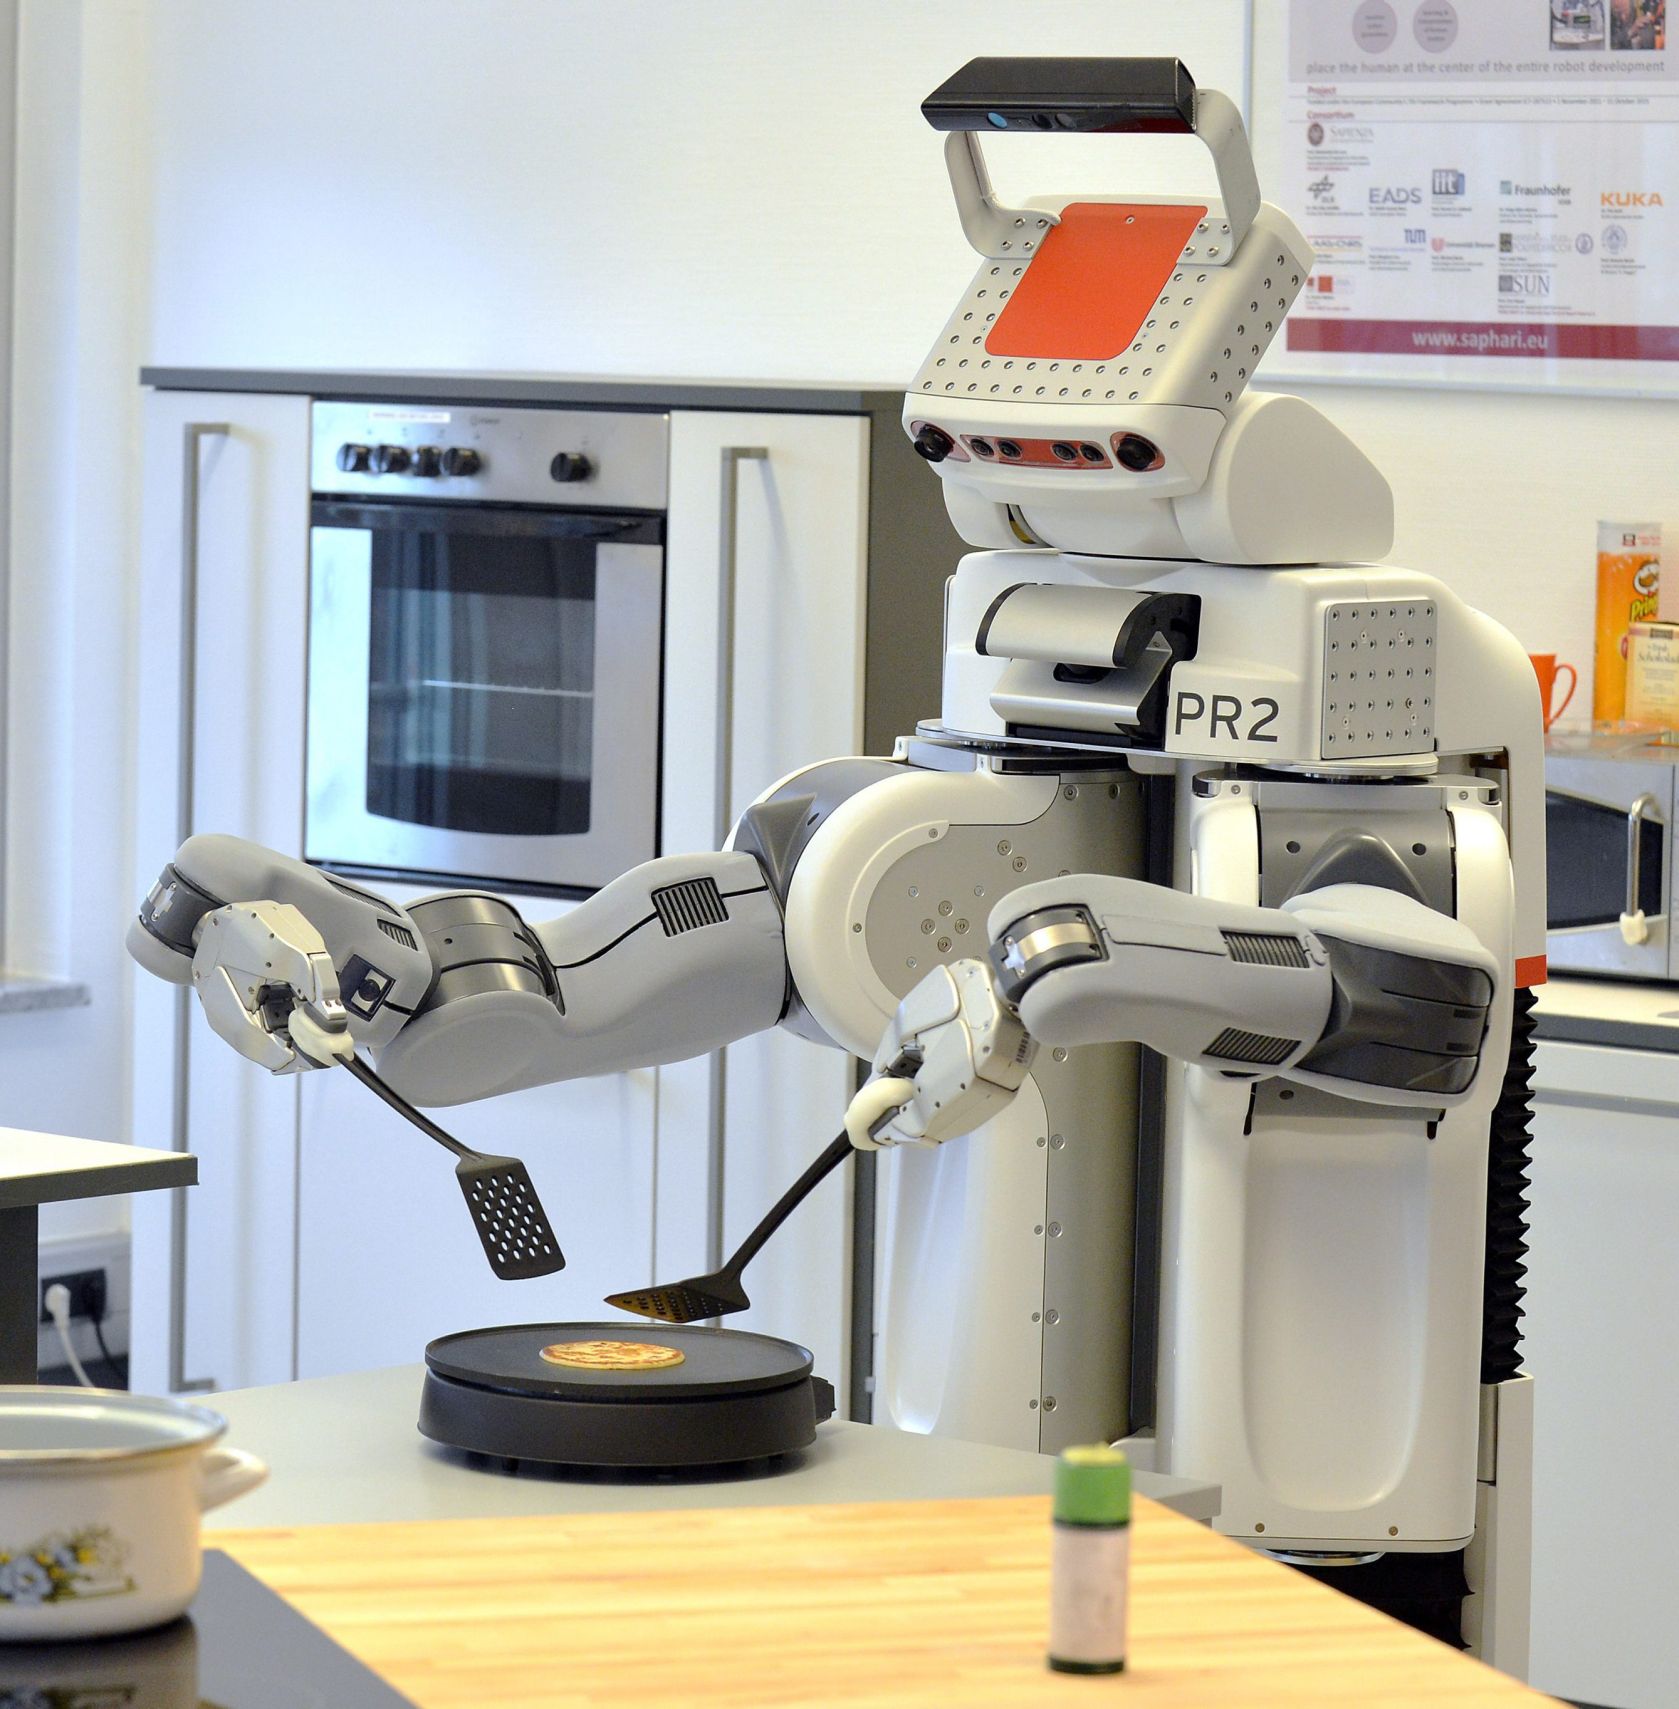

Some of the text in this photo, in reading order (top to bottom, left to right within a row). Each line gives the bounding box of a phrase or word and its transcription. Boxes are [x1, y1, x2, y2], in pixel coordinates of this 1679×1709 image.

[1306, 60, 1665, 75] place the human at the center of the entire robot development
[1307, 85, 1337, 97] Project
[1368, 187, 1422, 204] EADS
[1514, 184, 1571, 197] Fraunhofer
[1601, 192, 1664, 207] KUKA
[1512, 275, 1550, 294] SUN
[1412, 329, 1549, 351] www.saphari.eu
[1175, 691, 1279, 742] PR2
